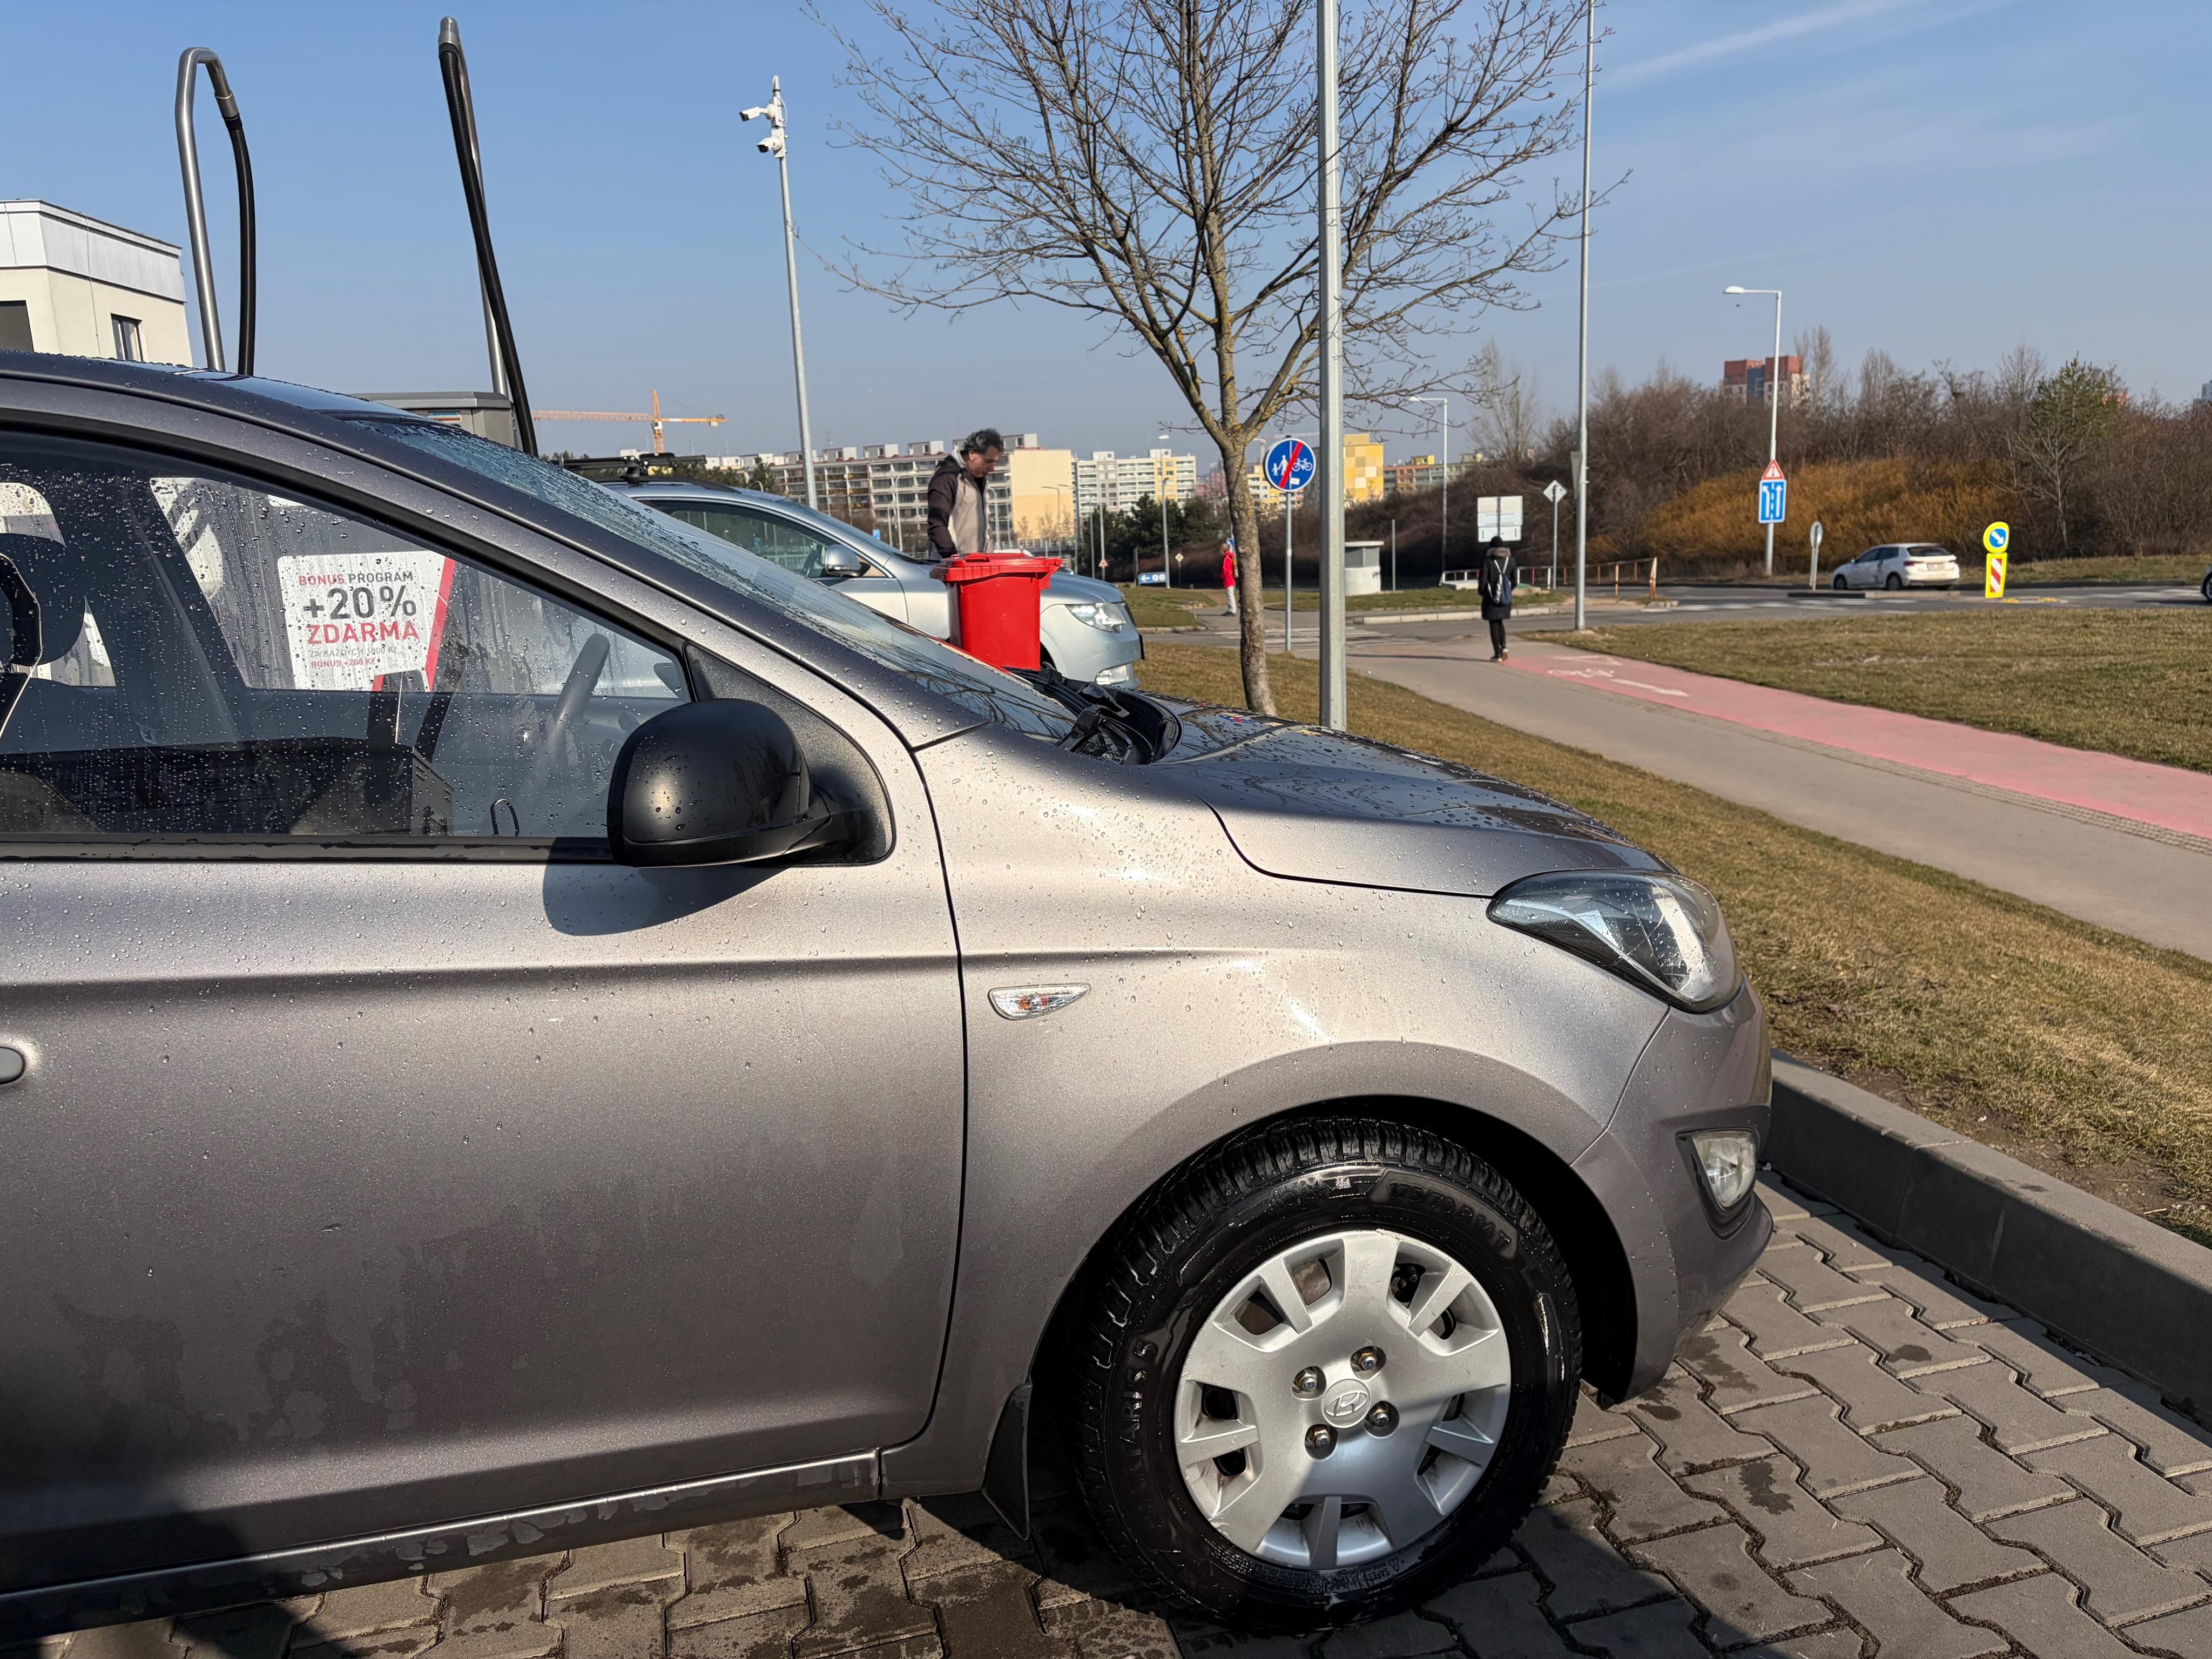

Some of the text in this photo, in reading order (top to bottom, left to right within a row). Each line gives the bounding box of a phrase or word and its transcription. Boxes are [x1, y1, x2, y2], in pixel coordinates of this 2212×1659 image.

[298, 571, 413, 586] BONUS PROGRAM
[302, 585, 417, 620] +20%
[307, 621, 420, 645] ZDARMA
[311, 659, 342, 668] BONUS
[1389, 1182, 1456, 1213] 175/70
